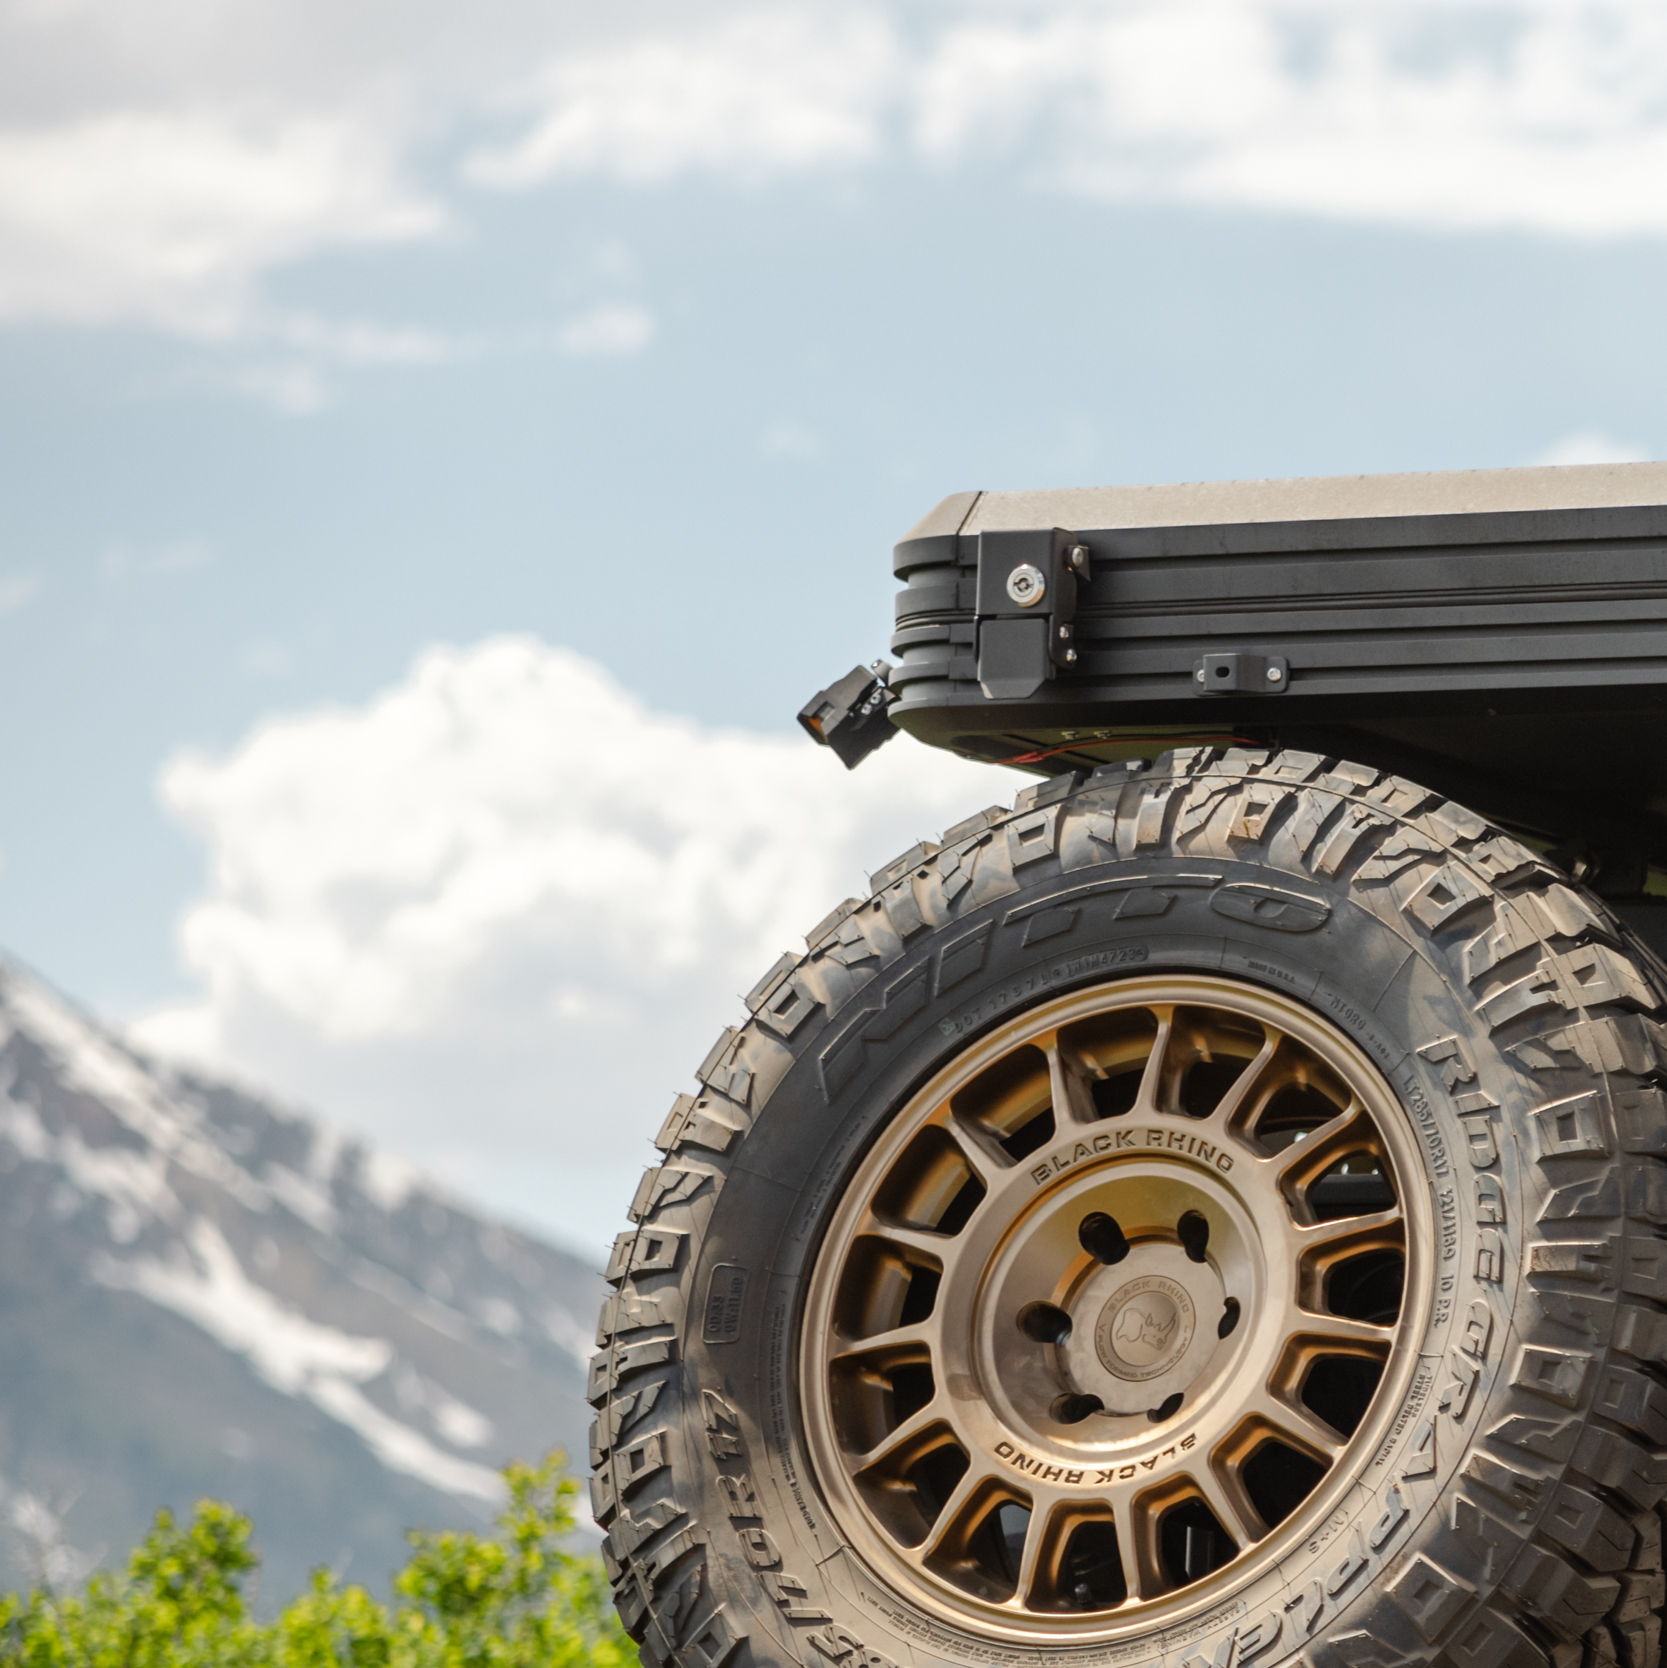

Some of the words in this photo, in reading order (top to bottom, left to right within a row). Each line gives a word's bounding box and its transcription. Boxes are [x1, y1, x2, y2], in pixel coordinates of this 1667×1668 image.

[815, 873, 1332, 1103] NITTO
[1031, 1127, 1138, 1186] BLACK
[1145, 1127, 1234, 1175] RHINO
[1418, 1033, 1504, 1288] RIDGE
[1108, 1280, 1151, 1313] BLACK
[1158, 1281, 1190, 1314] RHINO
[993, 1438, 1080, 1486] RHINO
[1093, 1432, 1199, 1484] BLACK
